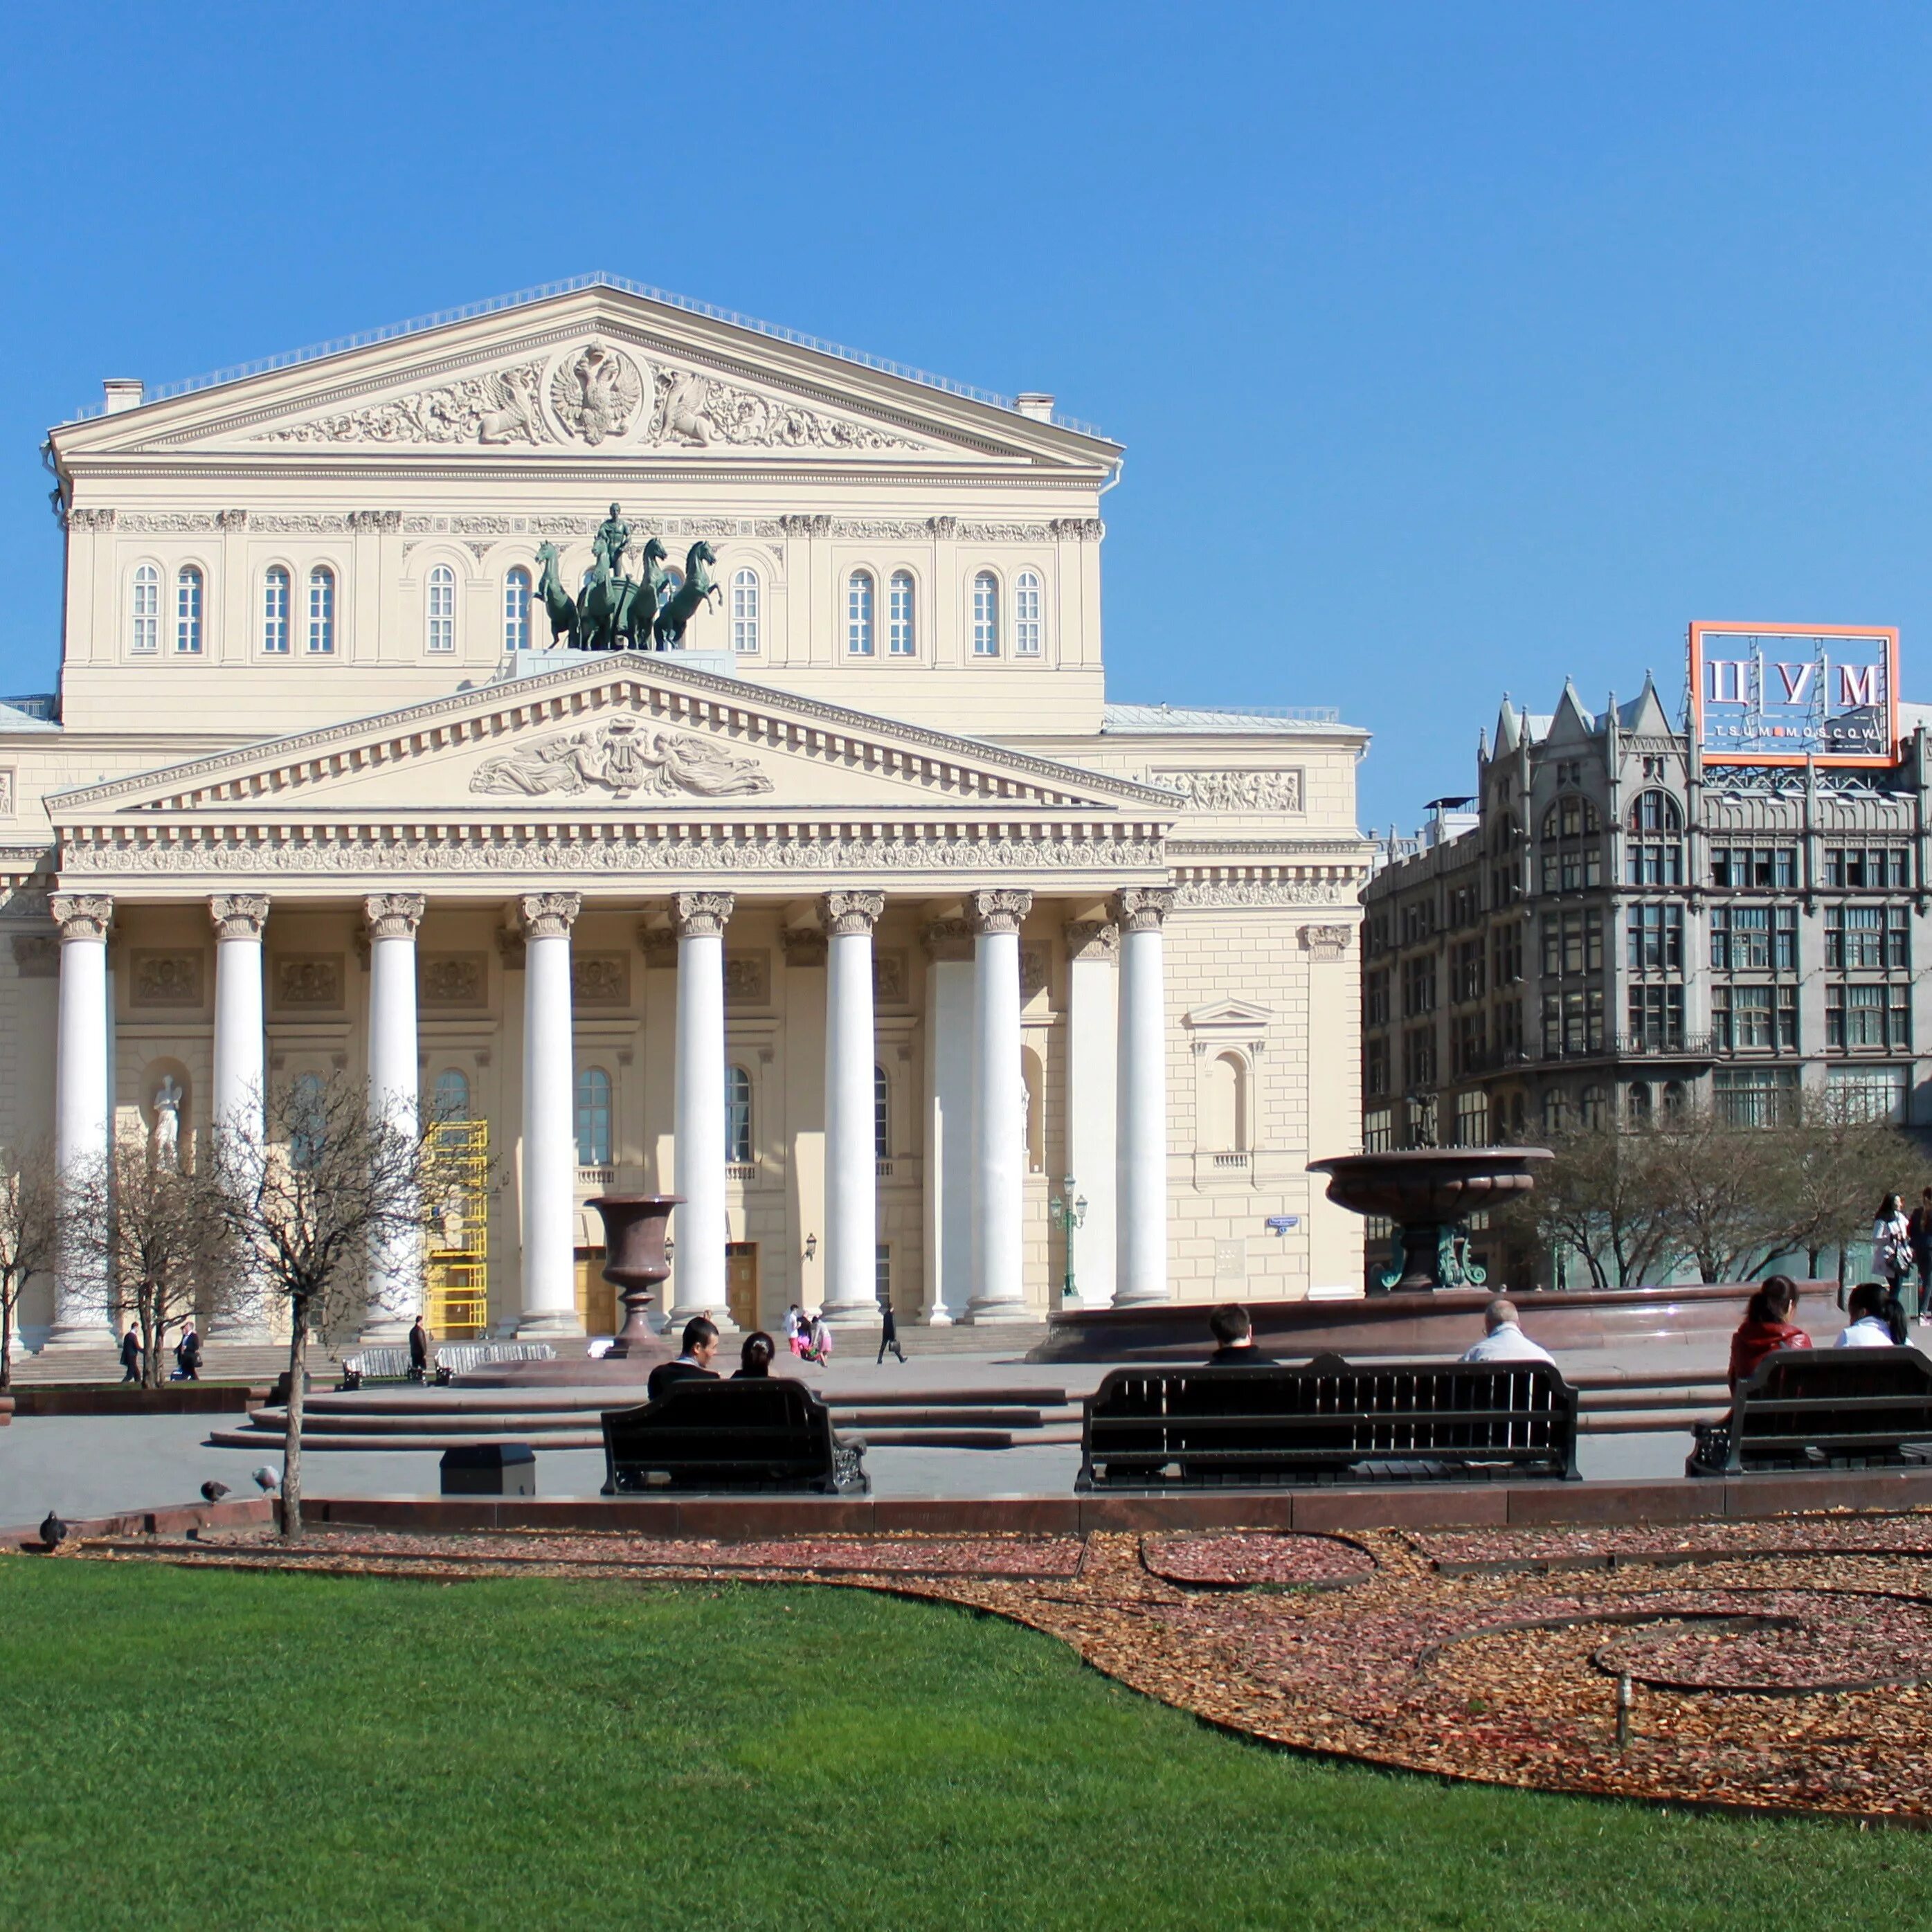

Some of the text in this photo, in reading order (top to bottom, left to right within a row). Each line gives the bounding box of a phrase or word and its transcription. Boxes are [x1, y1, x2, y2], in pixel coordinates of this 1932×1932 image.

[1706, 660, 1879, 707] ЦУМ
[1715, 725, 1877, 739] TSUM MOSCOW
